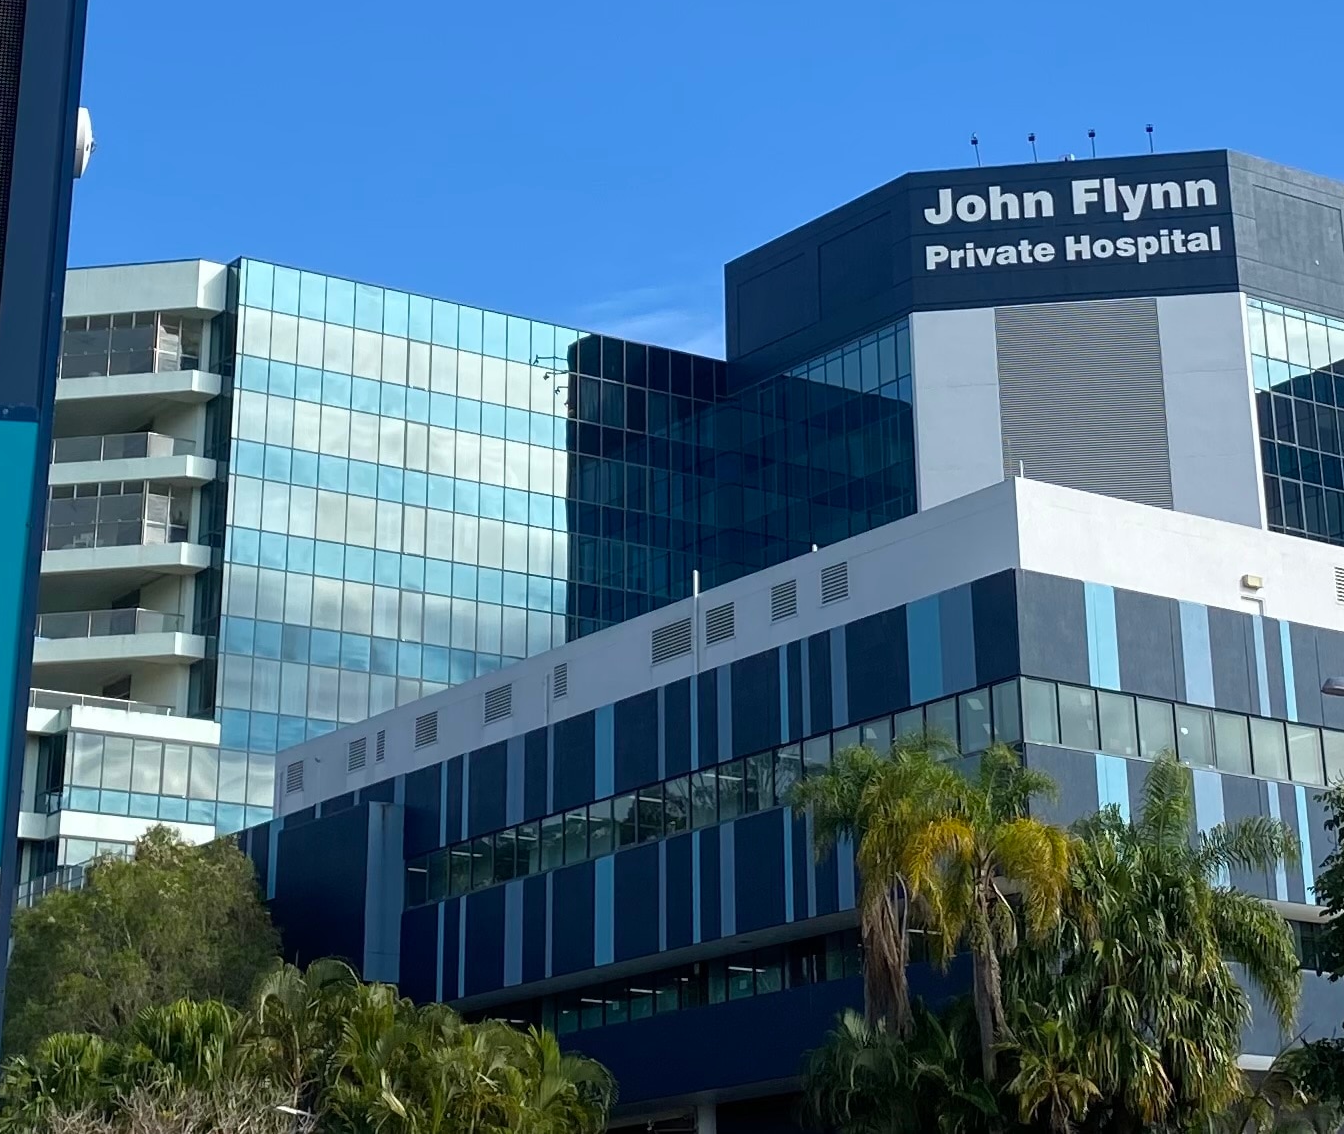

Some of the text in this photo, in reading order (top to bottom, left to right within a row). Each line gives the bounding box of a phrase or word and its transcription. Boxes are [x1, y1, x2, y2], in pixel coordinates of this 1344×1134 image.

[924, 177, 1218, 225] John Flynn
[925, 225, 1221, 270] Private Hospital
